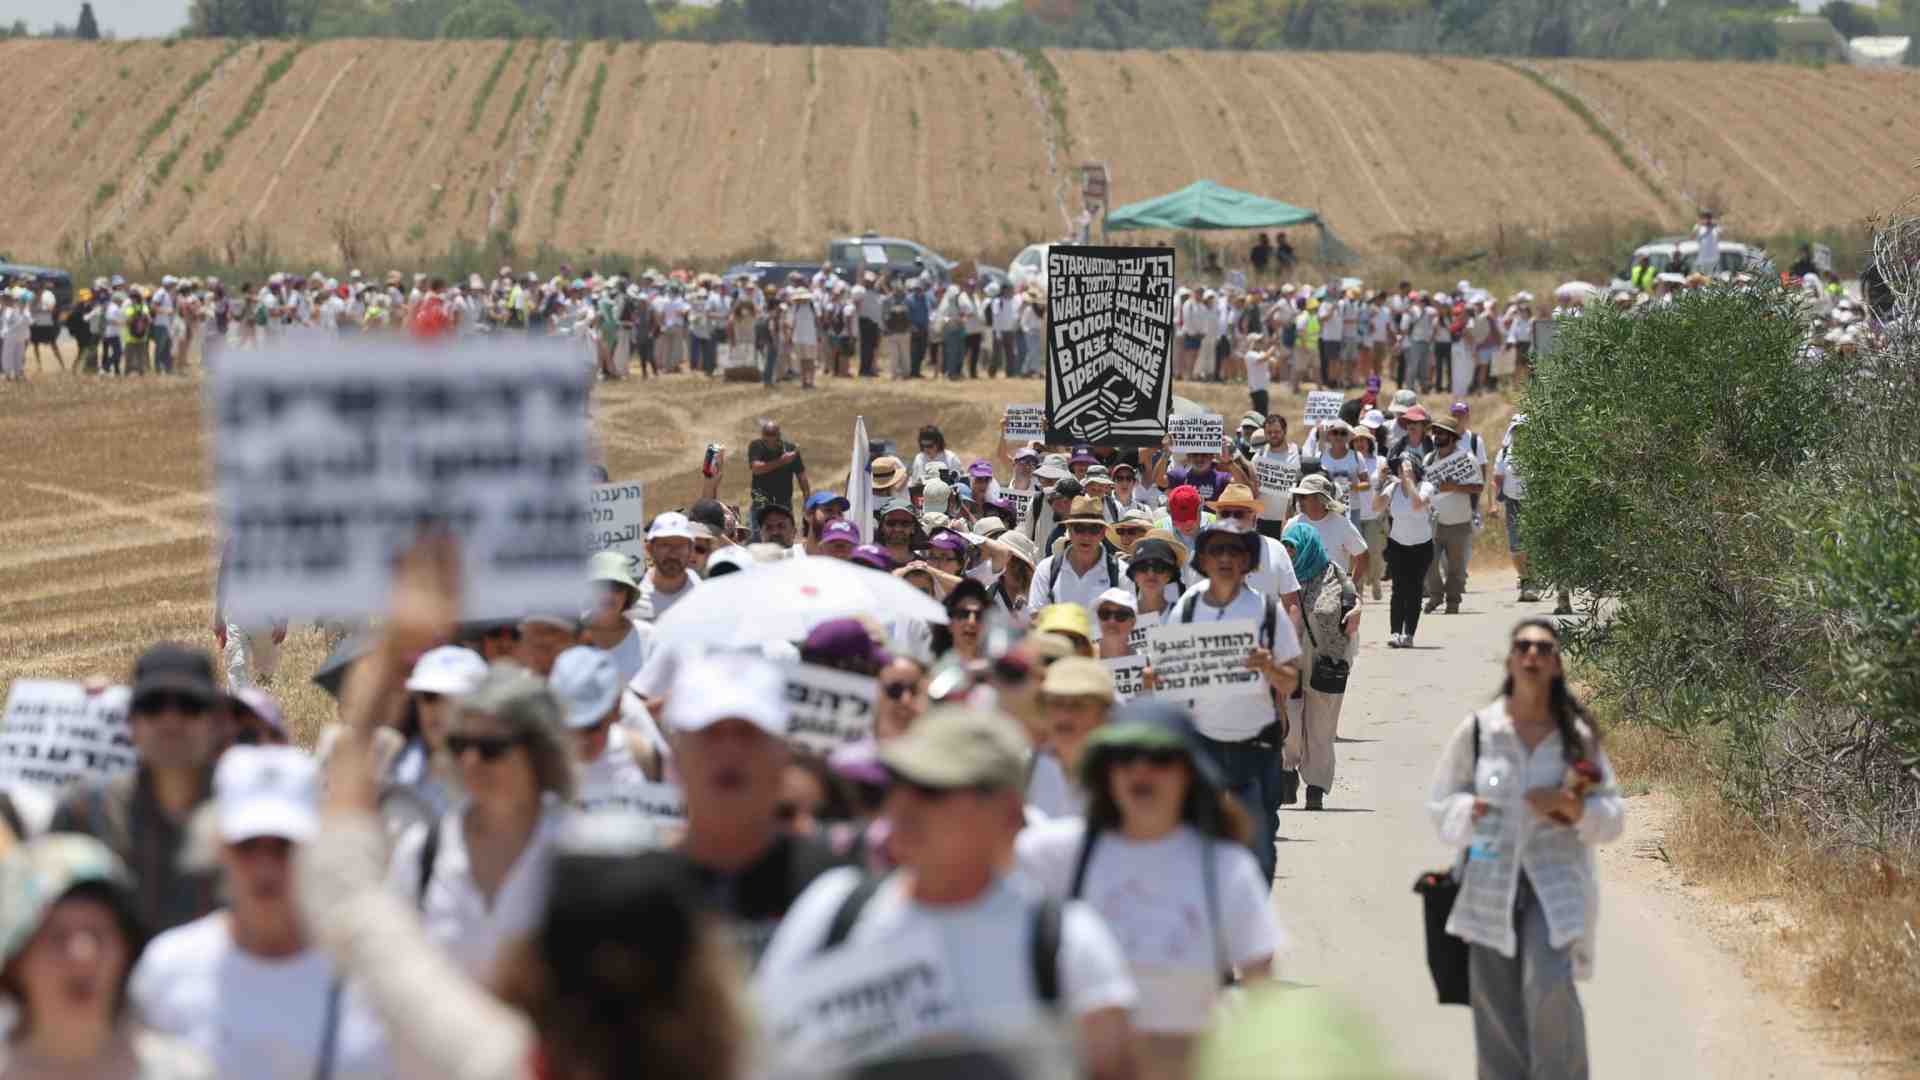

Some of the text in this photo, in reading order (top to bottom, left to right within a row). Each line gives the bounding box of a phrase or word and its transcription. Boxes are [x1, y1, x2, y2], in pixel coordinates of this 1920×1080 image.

[1050, 254, 1116, 275] STARVATION
[1118, 255, 1173, 276] הרעבה
[1051, 276, 1077, 297] IS A
[1147, 277, 1173, 297] היא
[1052, 292, 1113, 322] WAR CRIME
[1055, 312, 1112, 349] ГОЛОД
[1058, 332, 1162, 378] В ГАЗЕ ВОЕННОЕ
[1062, 351, 1157, 400] ПРЕСТУПЛЕНИЕ
[1198, 632, 1254, 648] להחזיר
